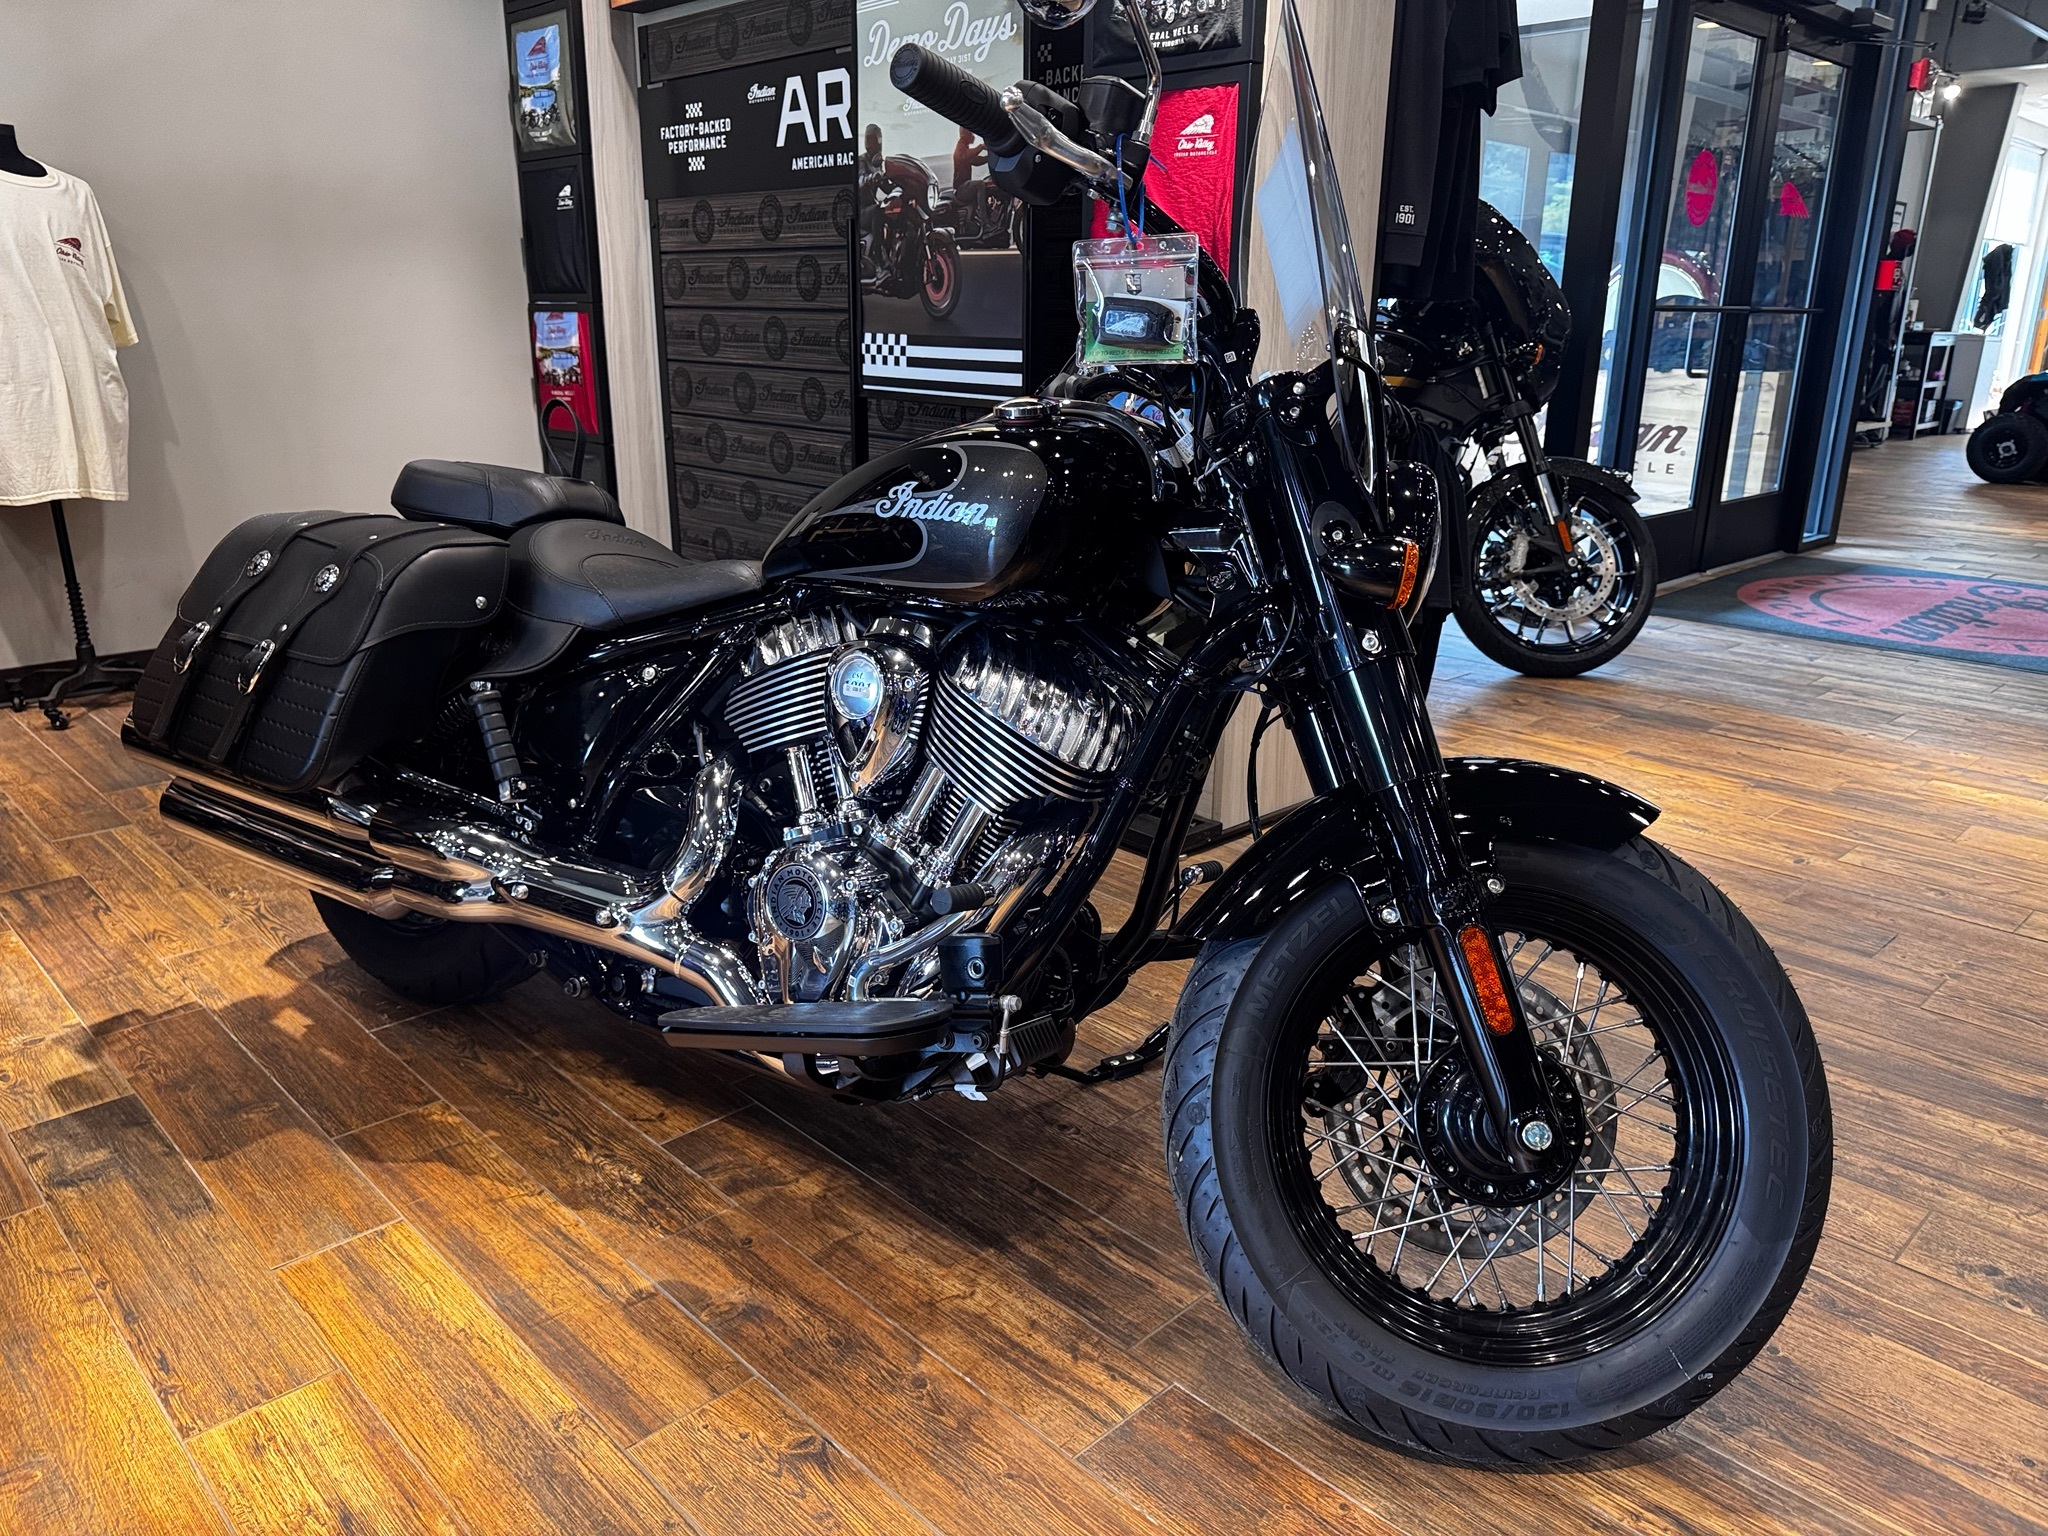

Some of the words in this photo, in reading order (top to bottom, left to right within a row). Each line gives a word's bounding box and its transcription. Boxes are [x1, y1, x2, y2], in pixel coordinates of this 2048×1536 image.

[938, 1, 1018, 62] Days
[1149, 30, 1170, 41] ERAL
[747, 83, 776, 100] Indian
[660, 118, 731, 140] FACTORY-BACKED
[668, 135, 727, 154] PERFORMANCE
[792, 156, 834, 170] AMERICAN
[837, 152, 854, 165] RAC
[787, 203, 828, 224] Indian
[1395, 213, 1415, 225] 1901
[1400, 205, 1414, 213] EST.
[753, 265, 792, 285] Indian
[875, 481, 989, 525] Indian
[771, 876, 784, 919] INDIAN
[787, 869, 823, 927] MOTORCYCLE
[1245, 897, 1356, 1020] METZEL
